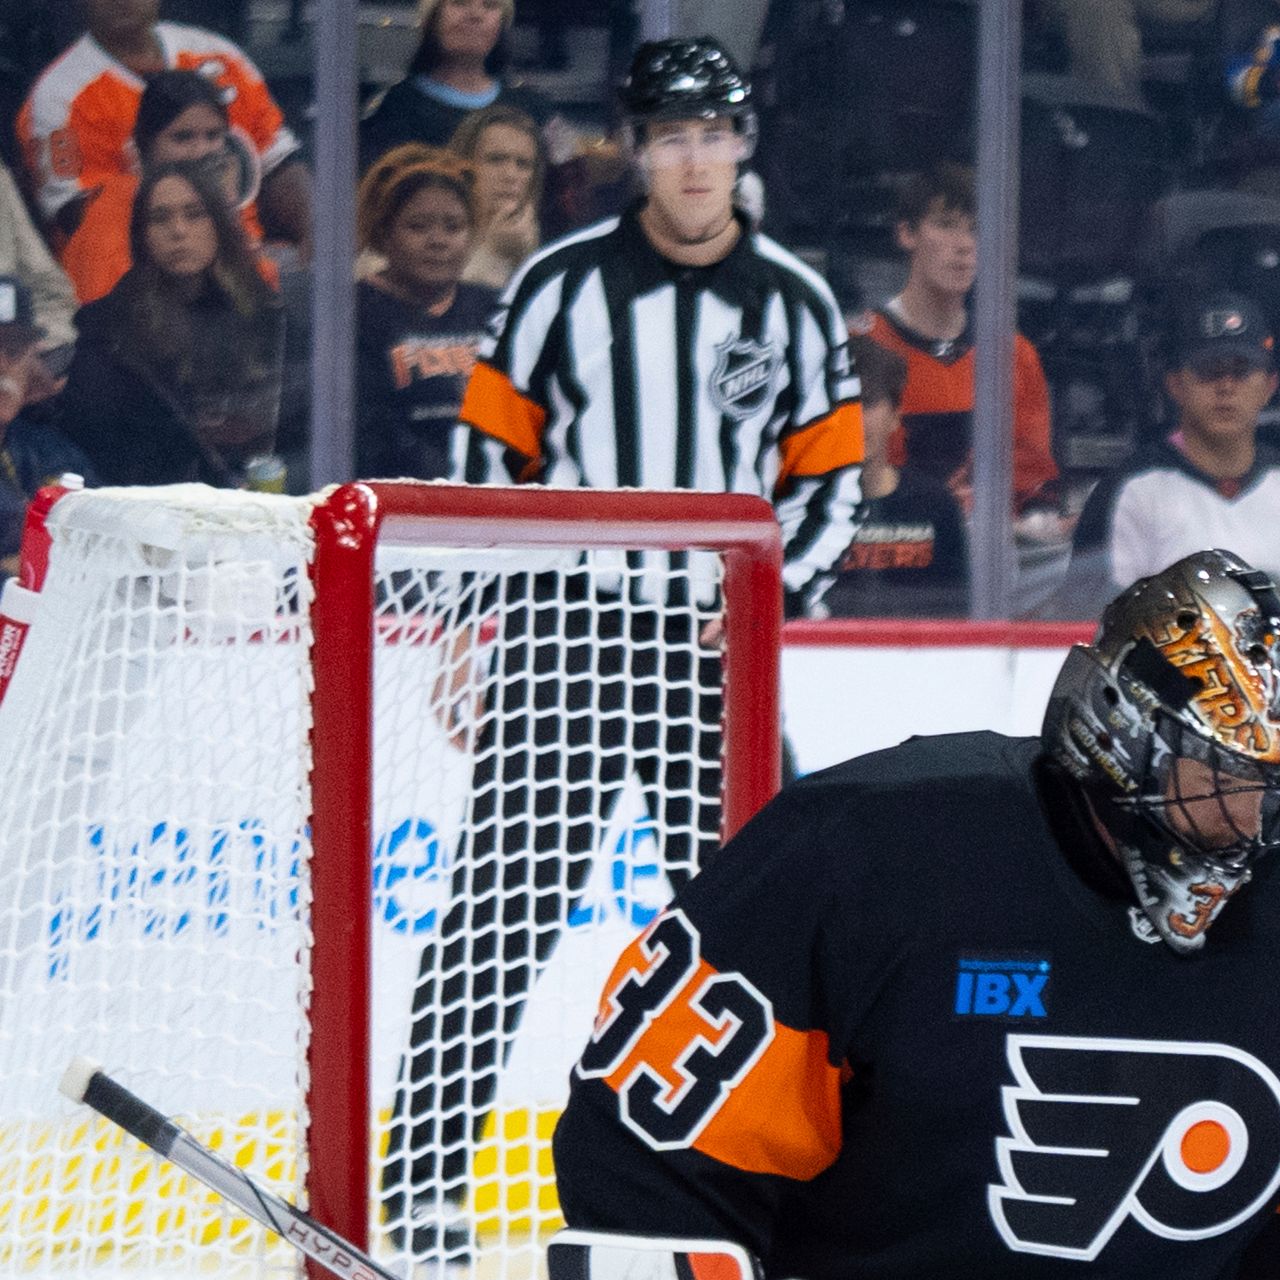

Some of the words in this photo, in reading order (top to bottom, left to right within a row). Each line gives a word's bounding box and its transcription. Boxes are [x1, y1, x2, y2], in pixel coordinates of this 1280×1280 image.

[722, 362, 772, 399] NHL
[955, 971, 1050, 1017] IBX
[574, 908, 776, 1152] 33
